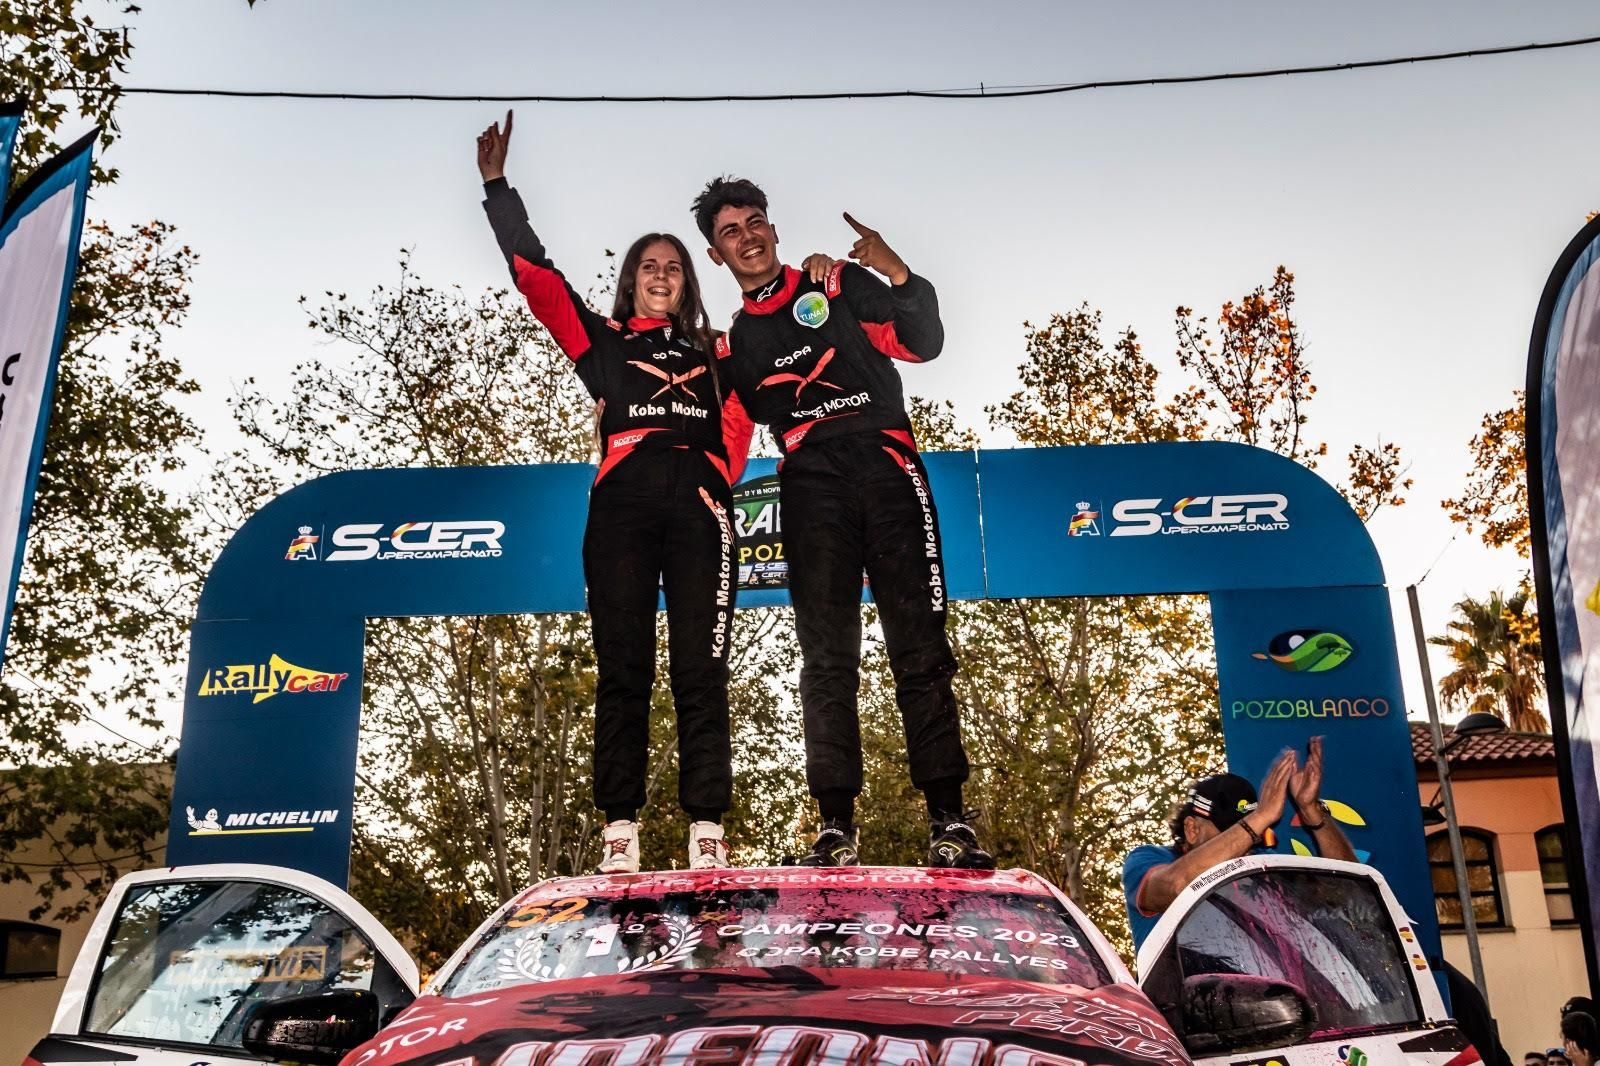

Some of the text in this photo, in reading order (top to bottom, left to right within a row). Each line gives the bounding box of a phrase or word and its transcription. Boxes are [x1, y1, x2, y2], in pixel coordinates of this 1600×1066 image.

[774, 345, 812, 368] COPA
[628, 401, 708, 419] Kobe Motor
[823, 391, 872, 414] MOTOR
[1109, 493, 1289, 537] S-CER
[324, 520, 506, 562] S-CER
[905, 462, 944, 612] Kobe Motorsport
[711, 507, 732, 658] Kobe Motorsport
[207, 666, 348, 693] Rallycar
[1232, 698, 1390, 720] POZOBLANCO
[225, 810, 339, 827] MICHELIN
[717, 922, 1081, 949] CAMPEONES 2023
[736, 946, 1069, 971] COPA KOBE RALLYES
